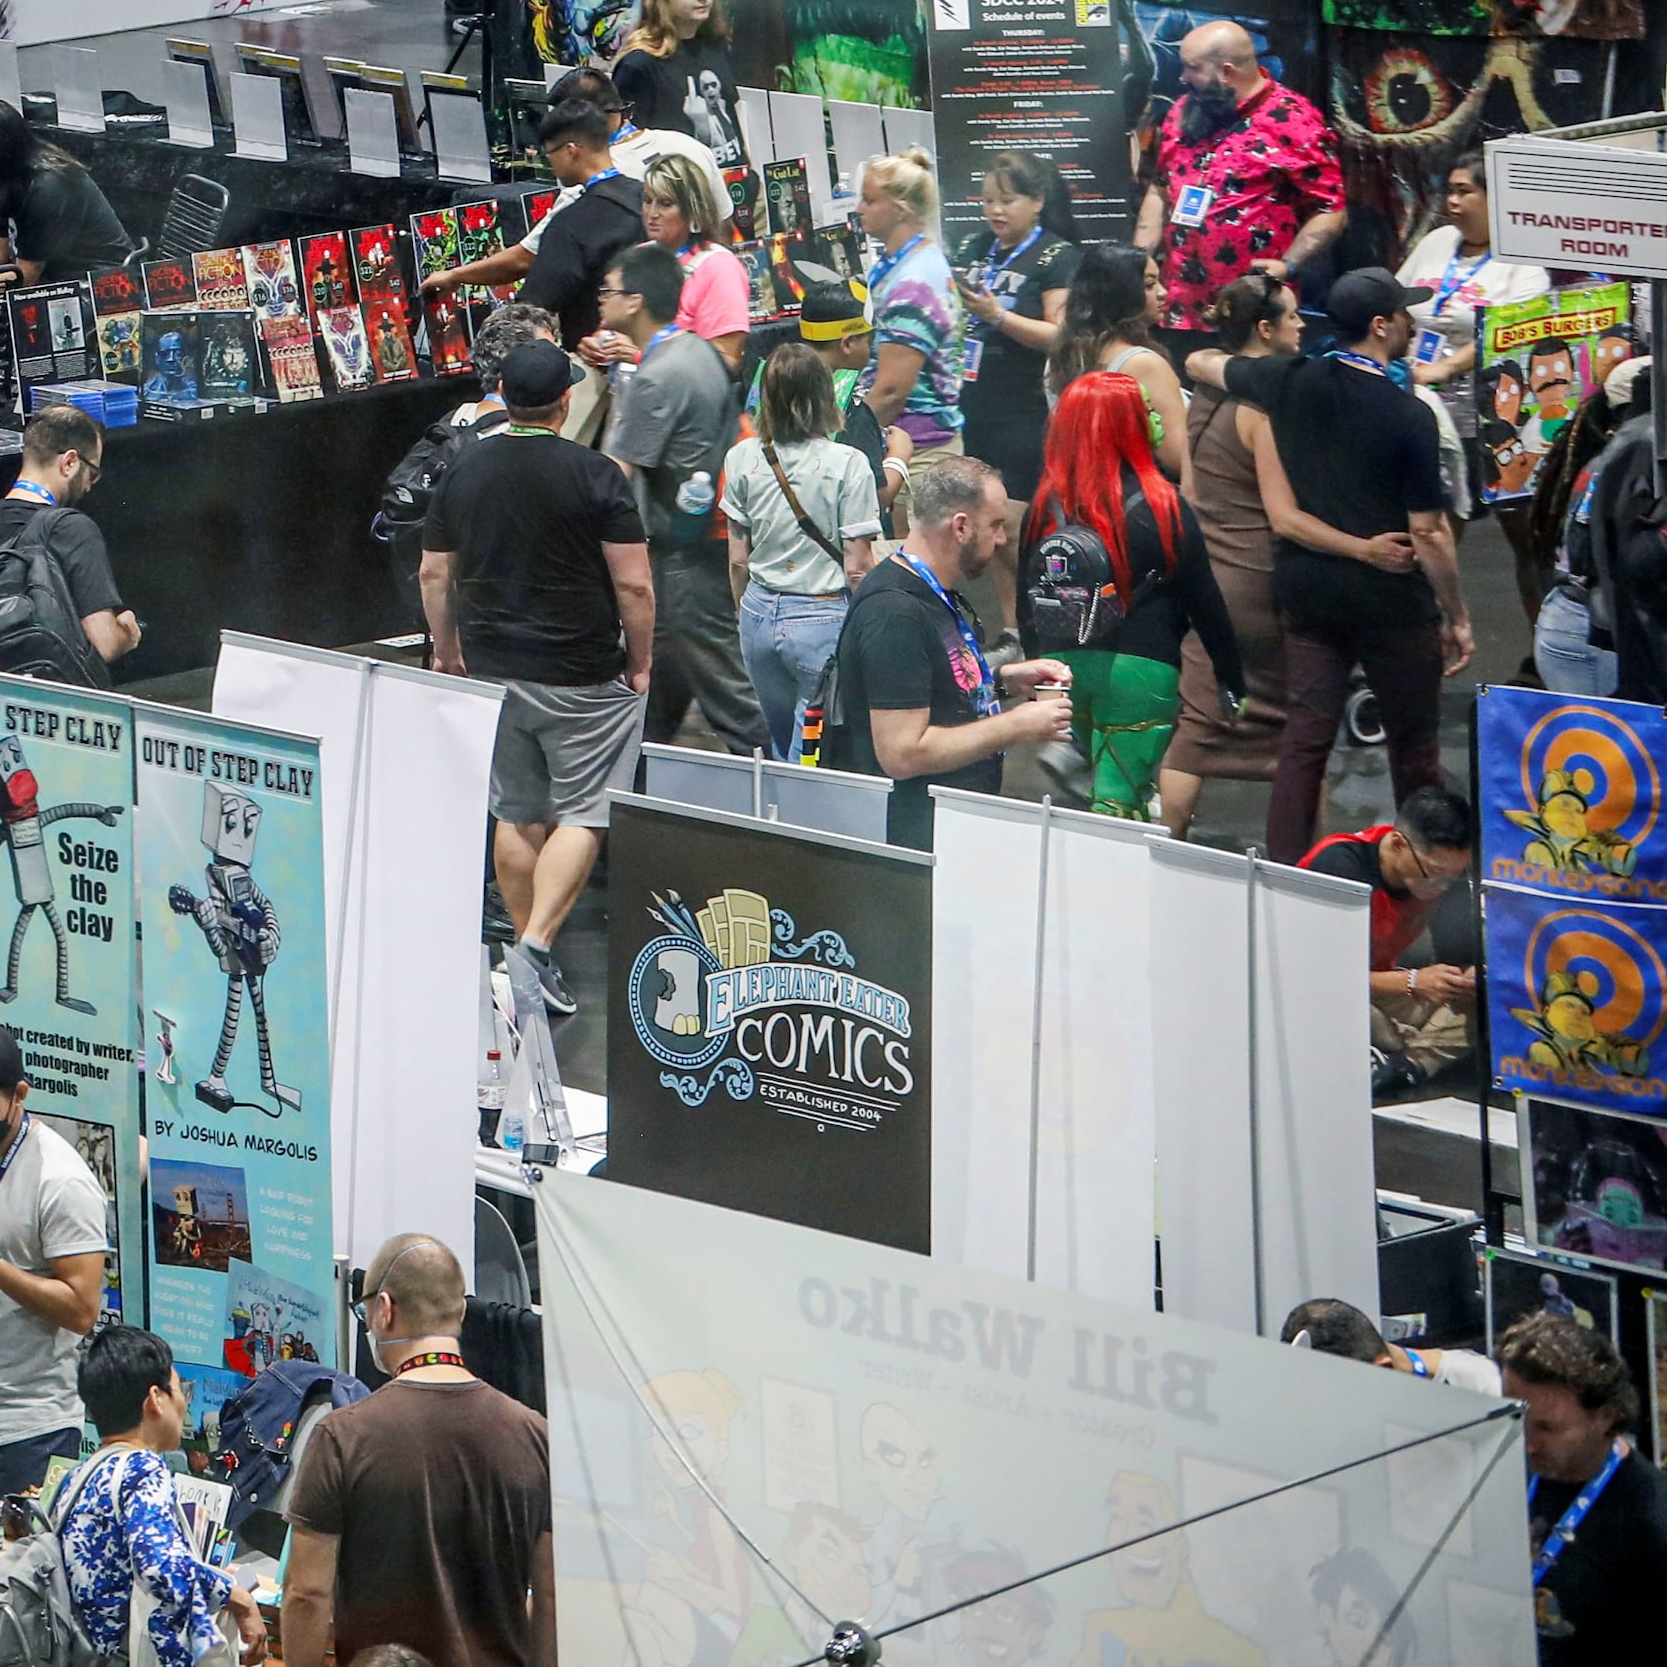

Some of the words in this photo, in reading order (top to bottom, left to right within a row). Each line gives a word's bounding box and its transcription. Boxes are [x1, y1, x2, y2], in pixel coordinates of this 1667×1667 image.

[982, 12, 1023, 22] Schedule
[1035, 12, 1066, 22] events
[1508, 211, 1667, 239] TRANSPORTE
[1561, 238, 1629, 258] ROOM
[1501, 325, 1538, 345] BOB'S
[1543, 314, 1610, 335] BURGERS
[5, 706, 61, 741] STEP
[65, 715, 123, 752] CLAY
[143, 737, 179, 765] OUT
[184, 744, 205, 773] OF
[210, 751, 259, 786] STEP
[264, 761, 314, 798] CLAY
[58, 832, 119, 874] Seize
[70, 874, 107, 905] the
[66, 906, 114, 942] clay
[708, 966, 834, 1033] ELEPHANT
[840, 974, 909, 1033] EATER
[26, 1030, 74, 1052] created
[76, 1036, 91, 1055] by
[92, 1041, 134, 1063] writer,
[736, 1012, 915, 1095] COMICS
[25, 1052, 110, 1082] photographer
[759, 1084, 849, 1112] ESTABLISHED
[851, 1105, 883, 1122] 2004
[155, 1120, 174, 1135] BY
[182, 1125, 238, 1149] JOSHUA
[244, 1135, 318, 1162] MARGOLIS
